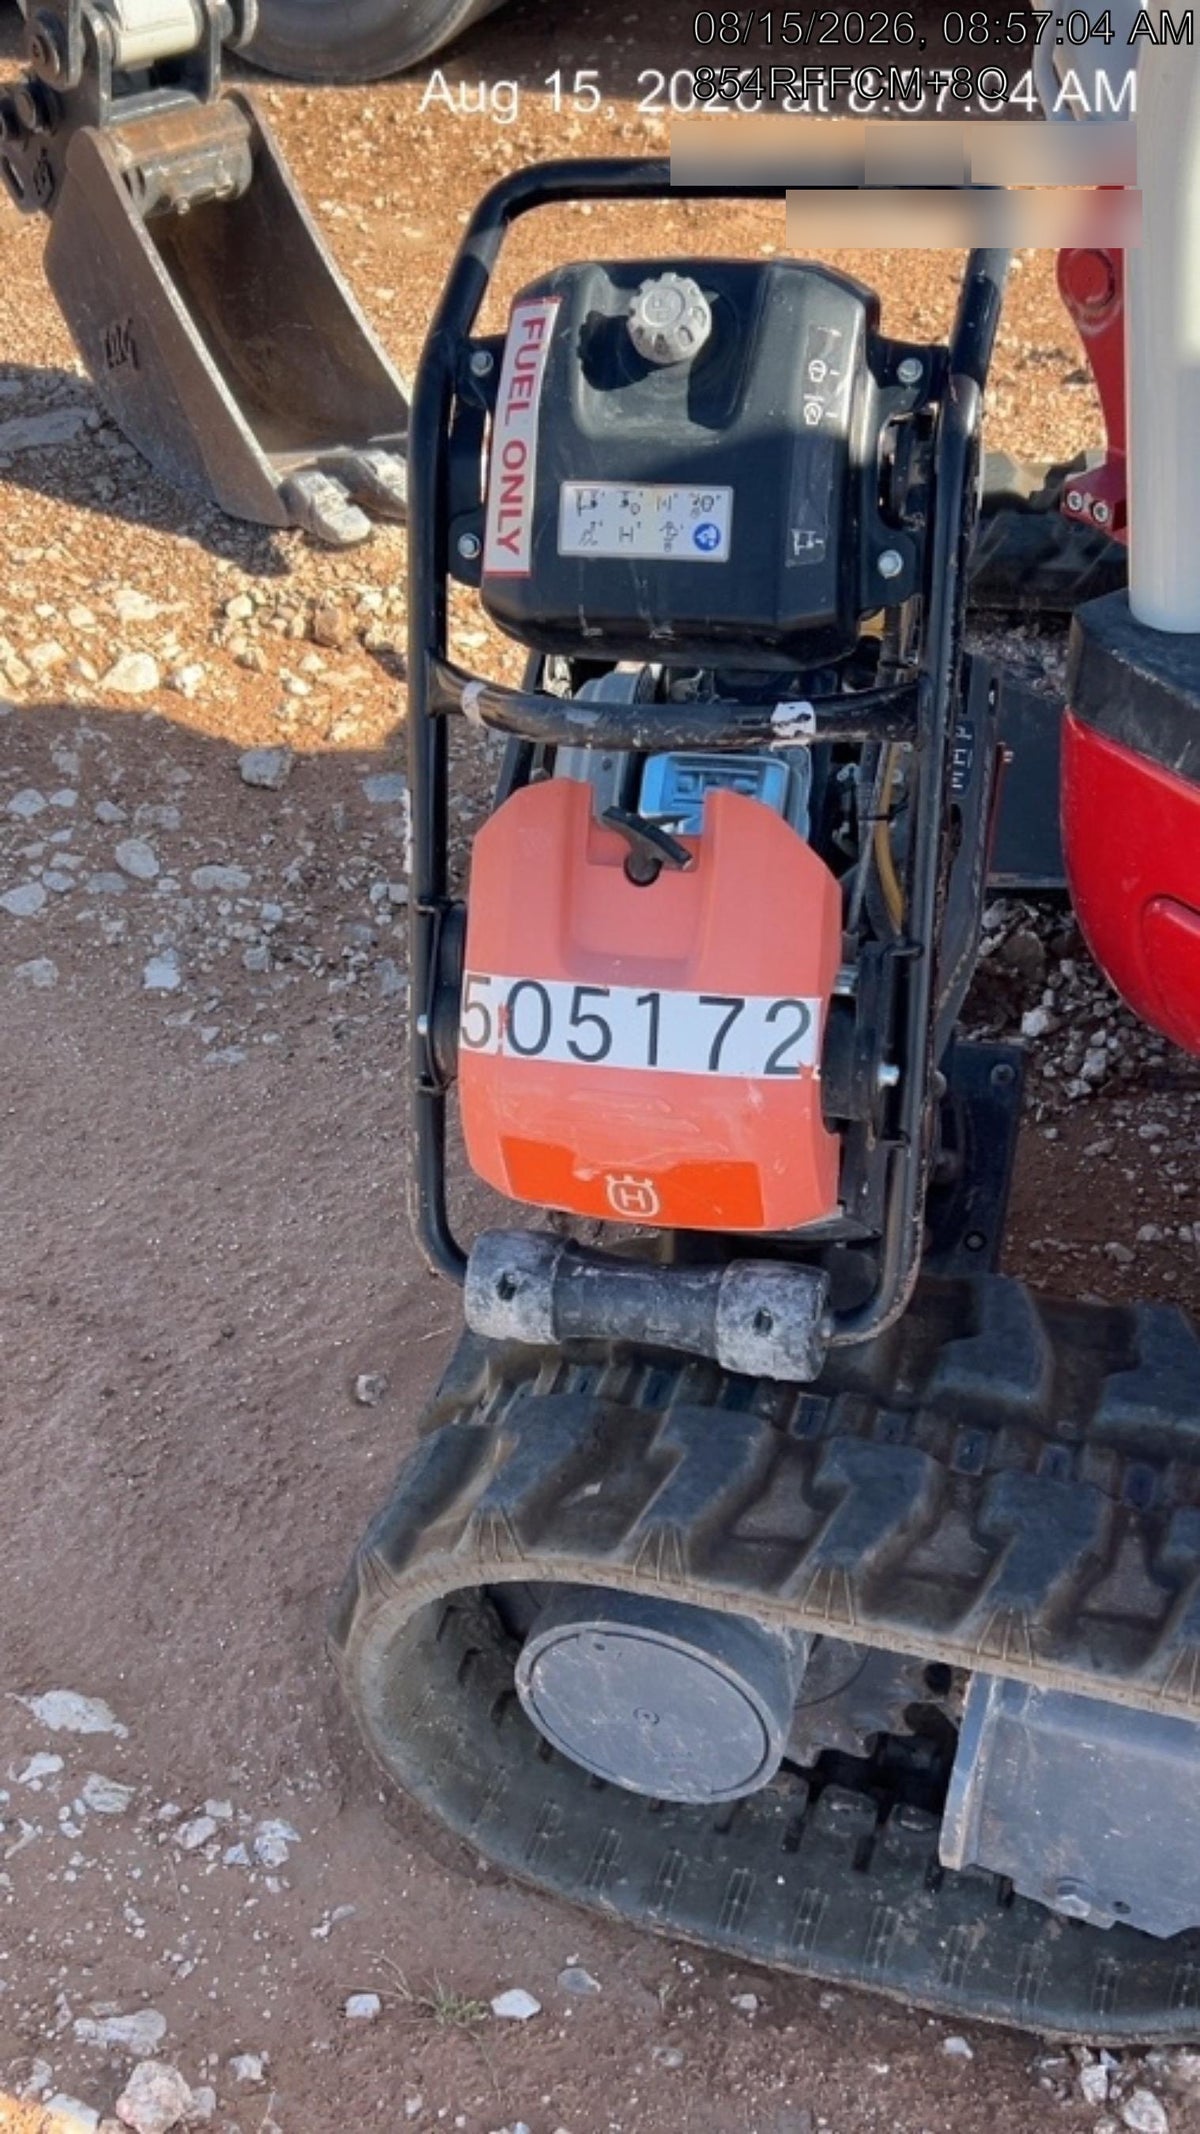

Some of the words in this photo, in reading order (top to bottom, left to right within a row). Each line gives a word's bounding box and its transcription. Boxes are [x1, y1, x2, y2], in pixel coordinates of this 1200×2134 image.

[504, 317, 546, 426] FUEL
[497, 440, 527, 555] ONLY
[460, 976, 812, 1075] 505172
